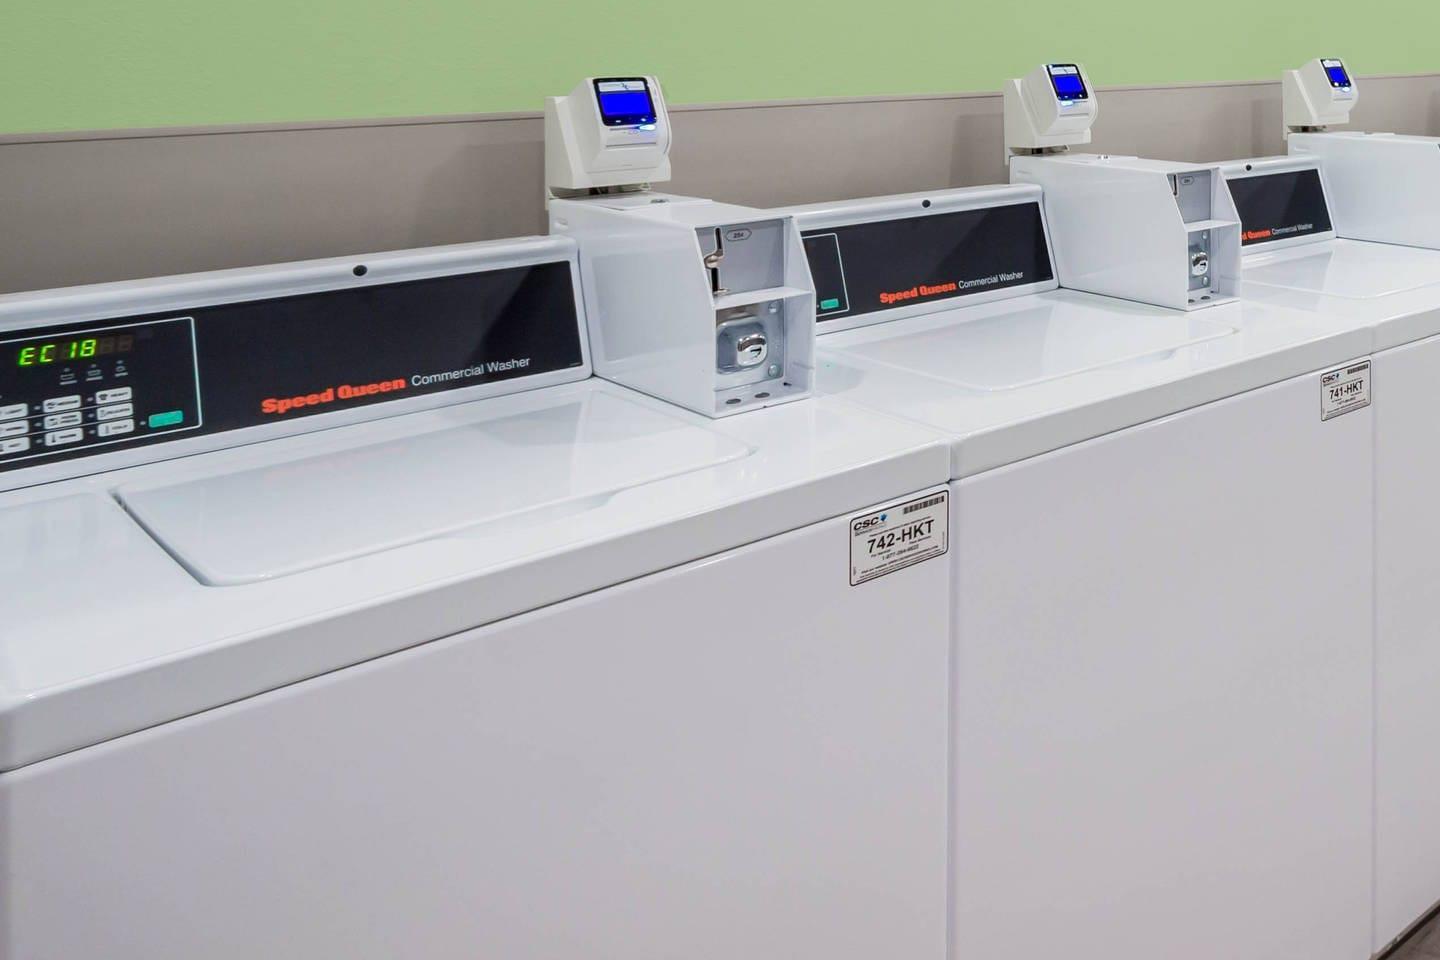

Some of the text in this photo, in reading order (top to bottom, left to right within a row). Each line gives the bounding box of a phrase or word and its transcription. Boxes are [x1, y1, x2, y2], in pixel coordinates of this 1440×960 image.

[879, 271, 1024, 304] Speed Queen Commercial Washer
[261, 356, 531, 414] Speed Queen Commercial Washer
[1329, 380, 1364, 400] 741-HKT
[853, 517, 879, 531] CSC
[867, 519, 935, 554] 742-HKT
